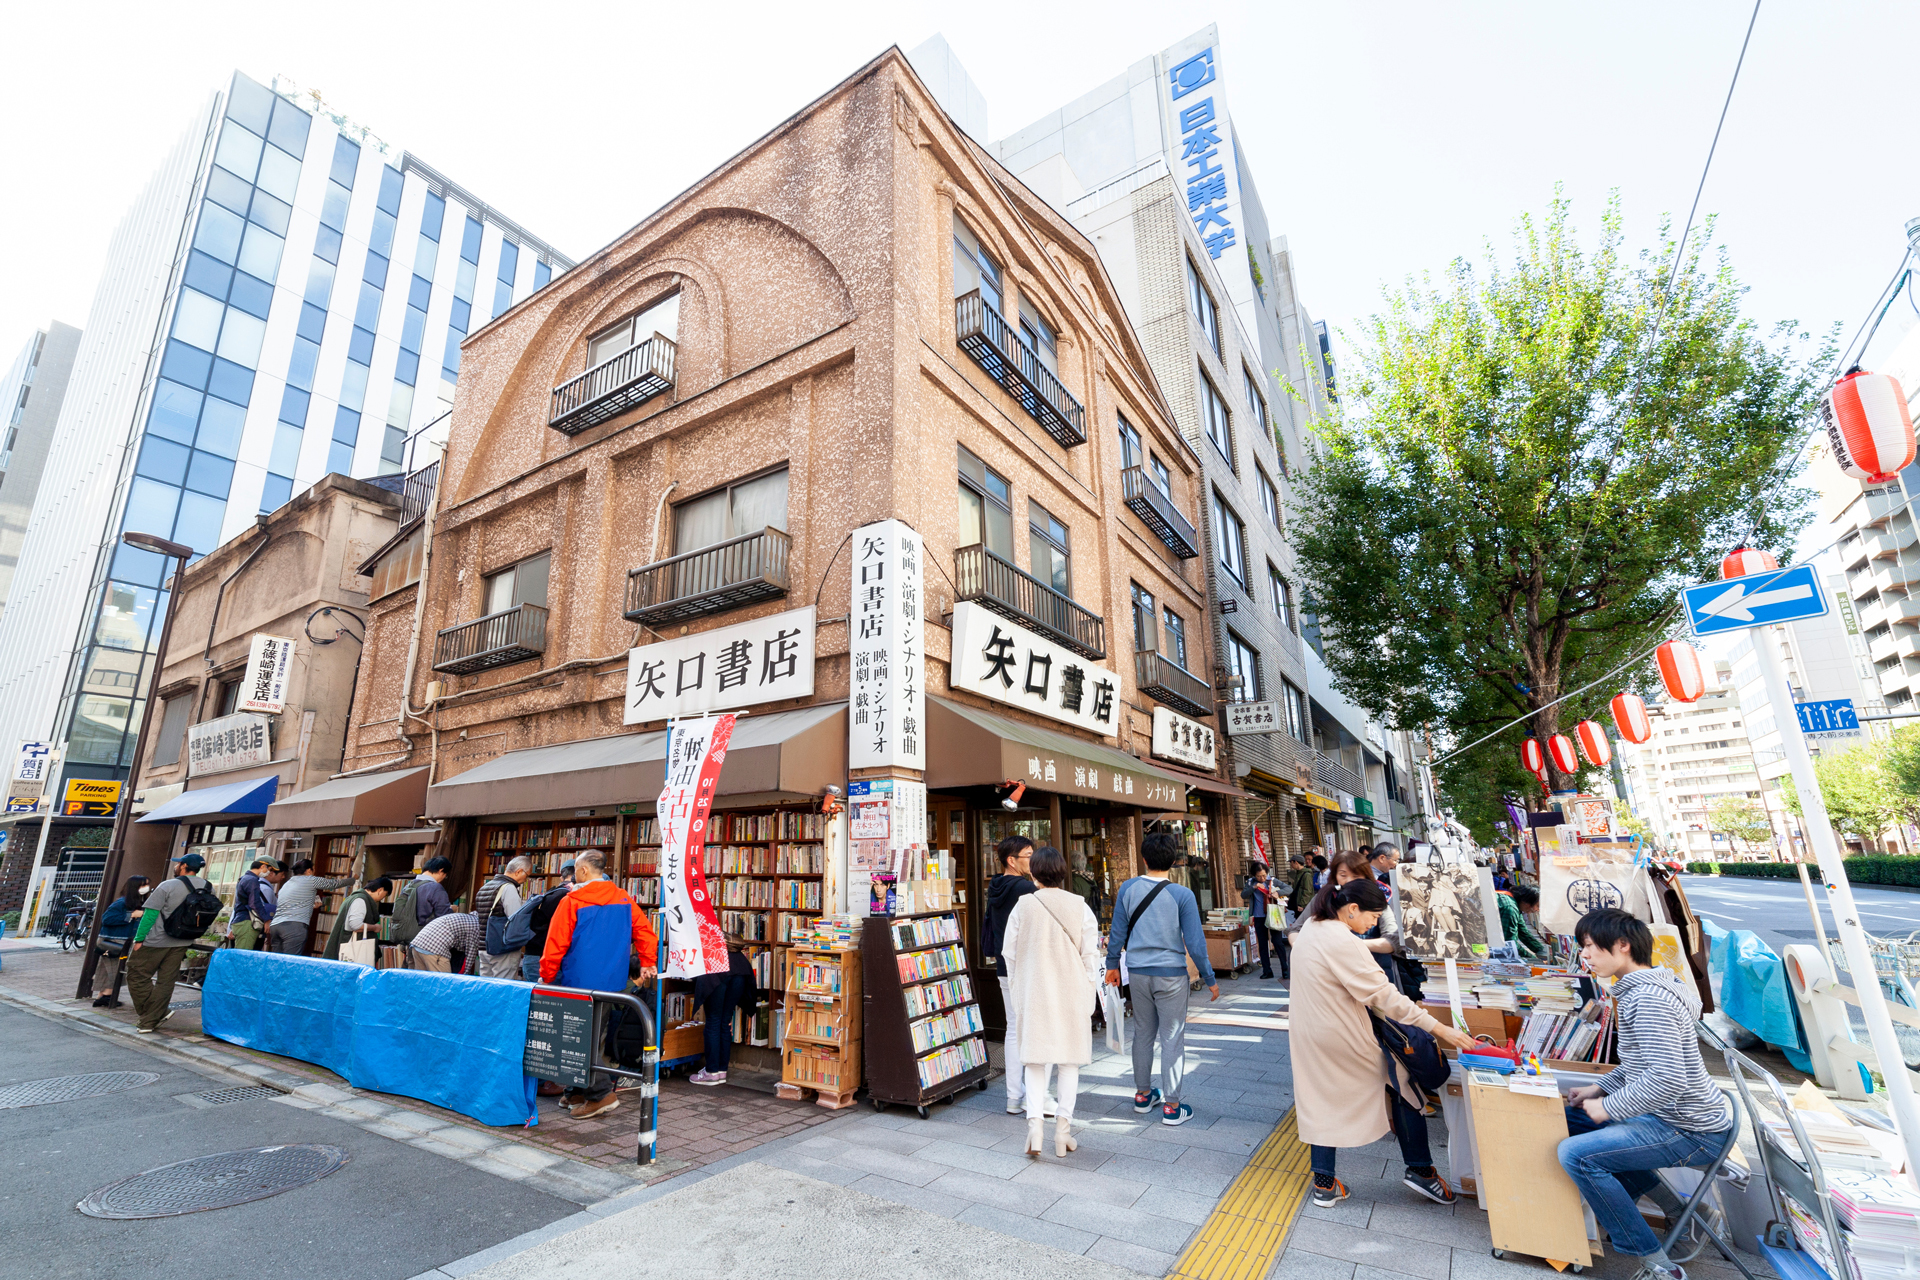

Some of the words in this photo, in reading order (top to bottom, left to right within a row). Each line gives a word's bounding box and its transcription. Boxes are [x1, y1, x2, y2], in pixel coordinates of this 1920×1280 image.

[859, 537, 885, 639] 矢口書店
[633, 628, 801, 708] 矢口書店
[901, 536, 917, 756] 映画・演劇・シナリオ・戯曲
[980, 624, 1115, 724] 矢口書店
[855, 651, 870, 726] 演劇・戯曲
[873, 648, 888, 754] 映画・シナリオ
[1232, 712, 1273, 725] 古賀書店
[20, 759, 37, 779] 質店
[74, 783, 116, 793] Times
[1028, 756, 1057, 783] 映画
[1075, 765, 1099, 790] 演劇
[1113, 773, 1133, 795] 戯曲
[1147, 782, 1177, 802] シナリオ
[67, 802, 83, 815] P
[855, 822, 884, 830] 古本まつり
